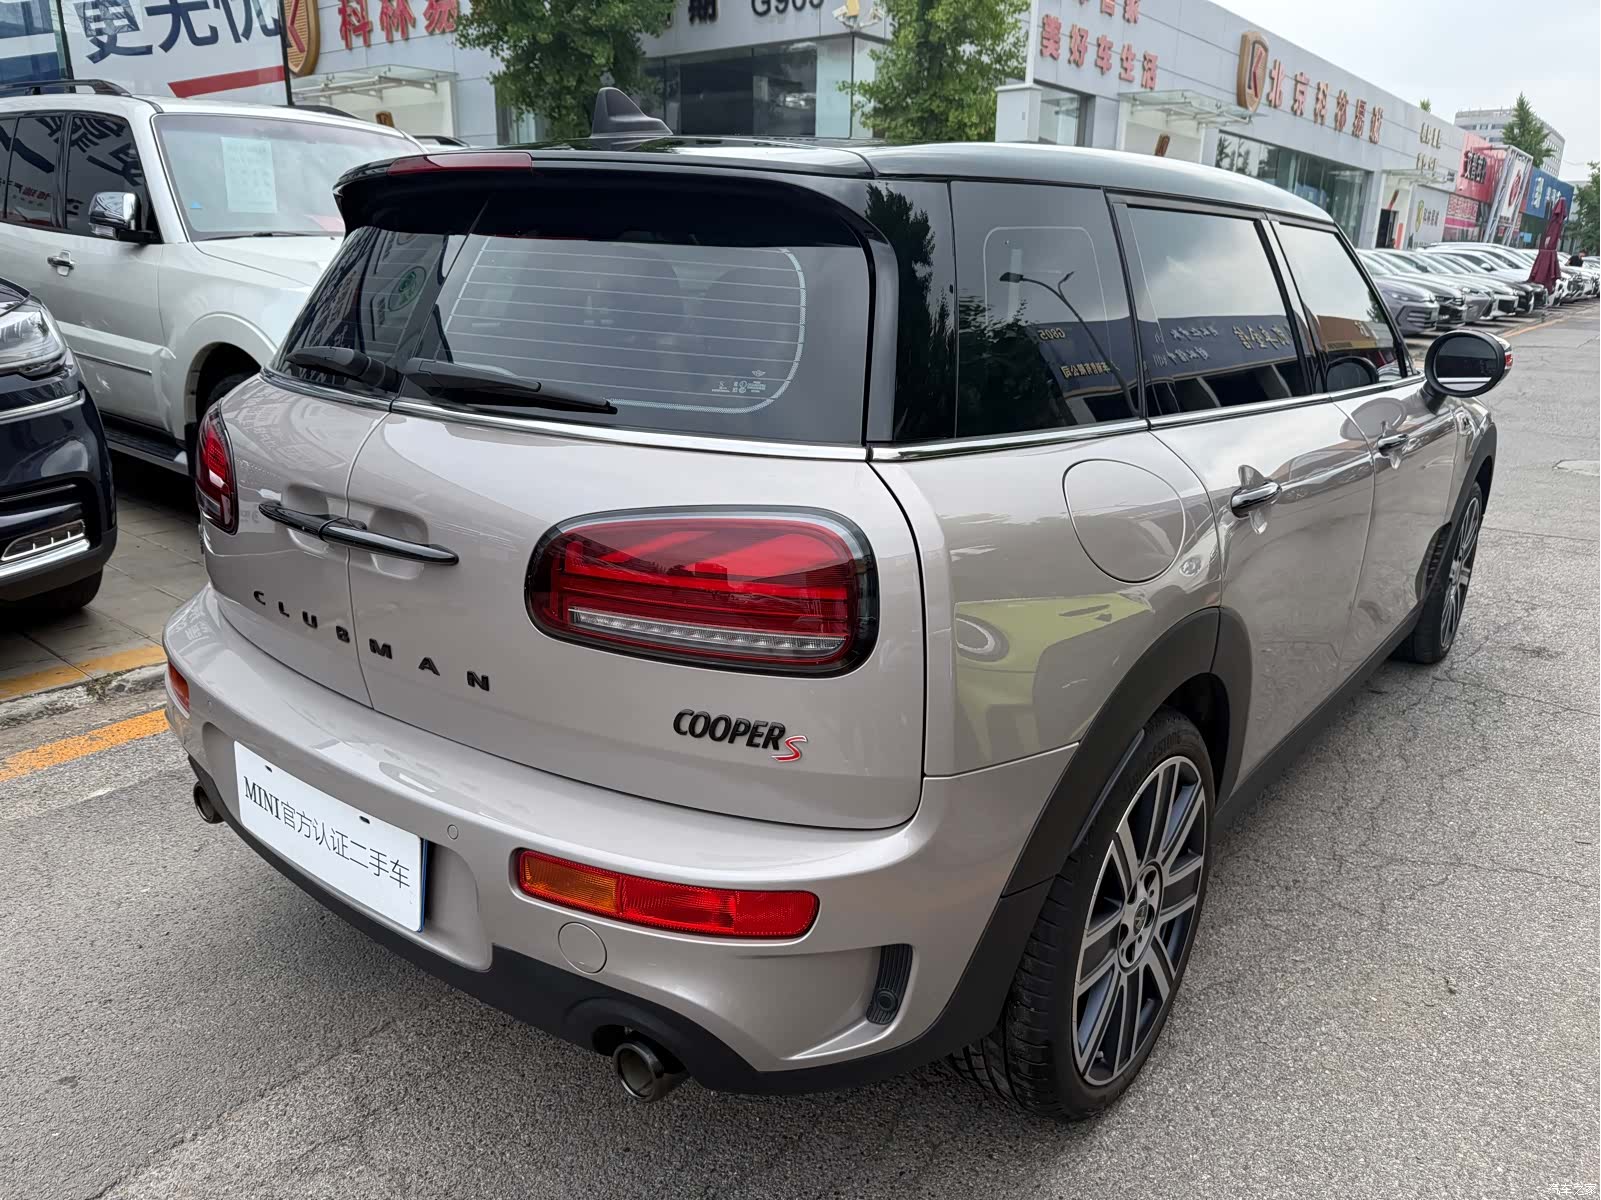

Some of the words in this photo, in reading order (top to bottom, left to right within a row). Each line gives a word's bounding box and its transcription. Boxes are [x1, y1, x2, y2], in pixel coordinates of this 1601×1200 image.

[1040, 14, 1158, 90] 美好车生活
[253, 590, 490, 692] CLUBMAN
[673, 708, 786, 751] COOPER
[771, 735, 808, 762] S
[243, 775, 411, 889] MINI官方认证二手车
